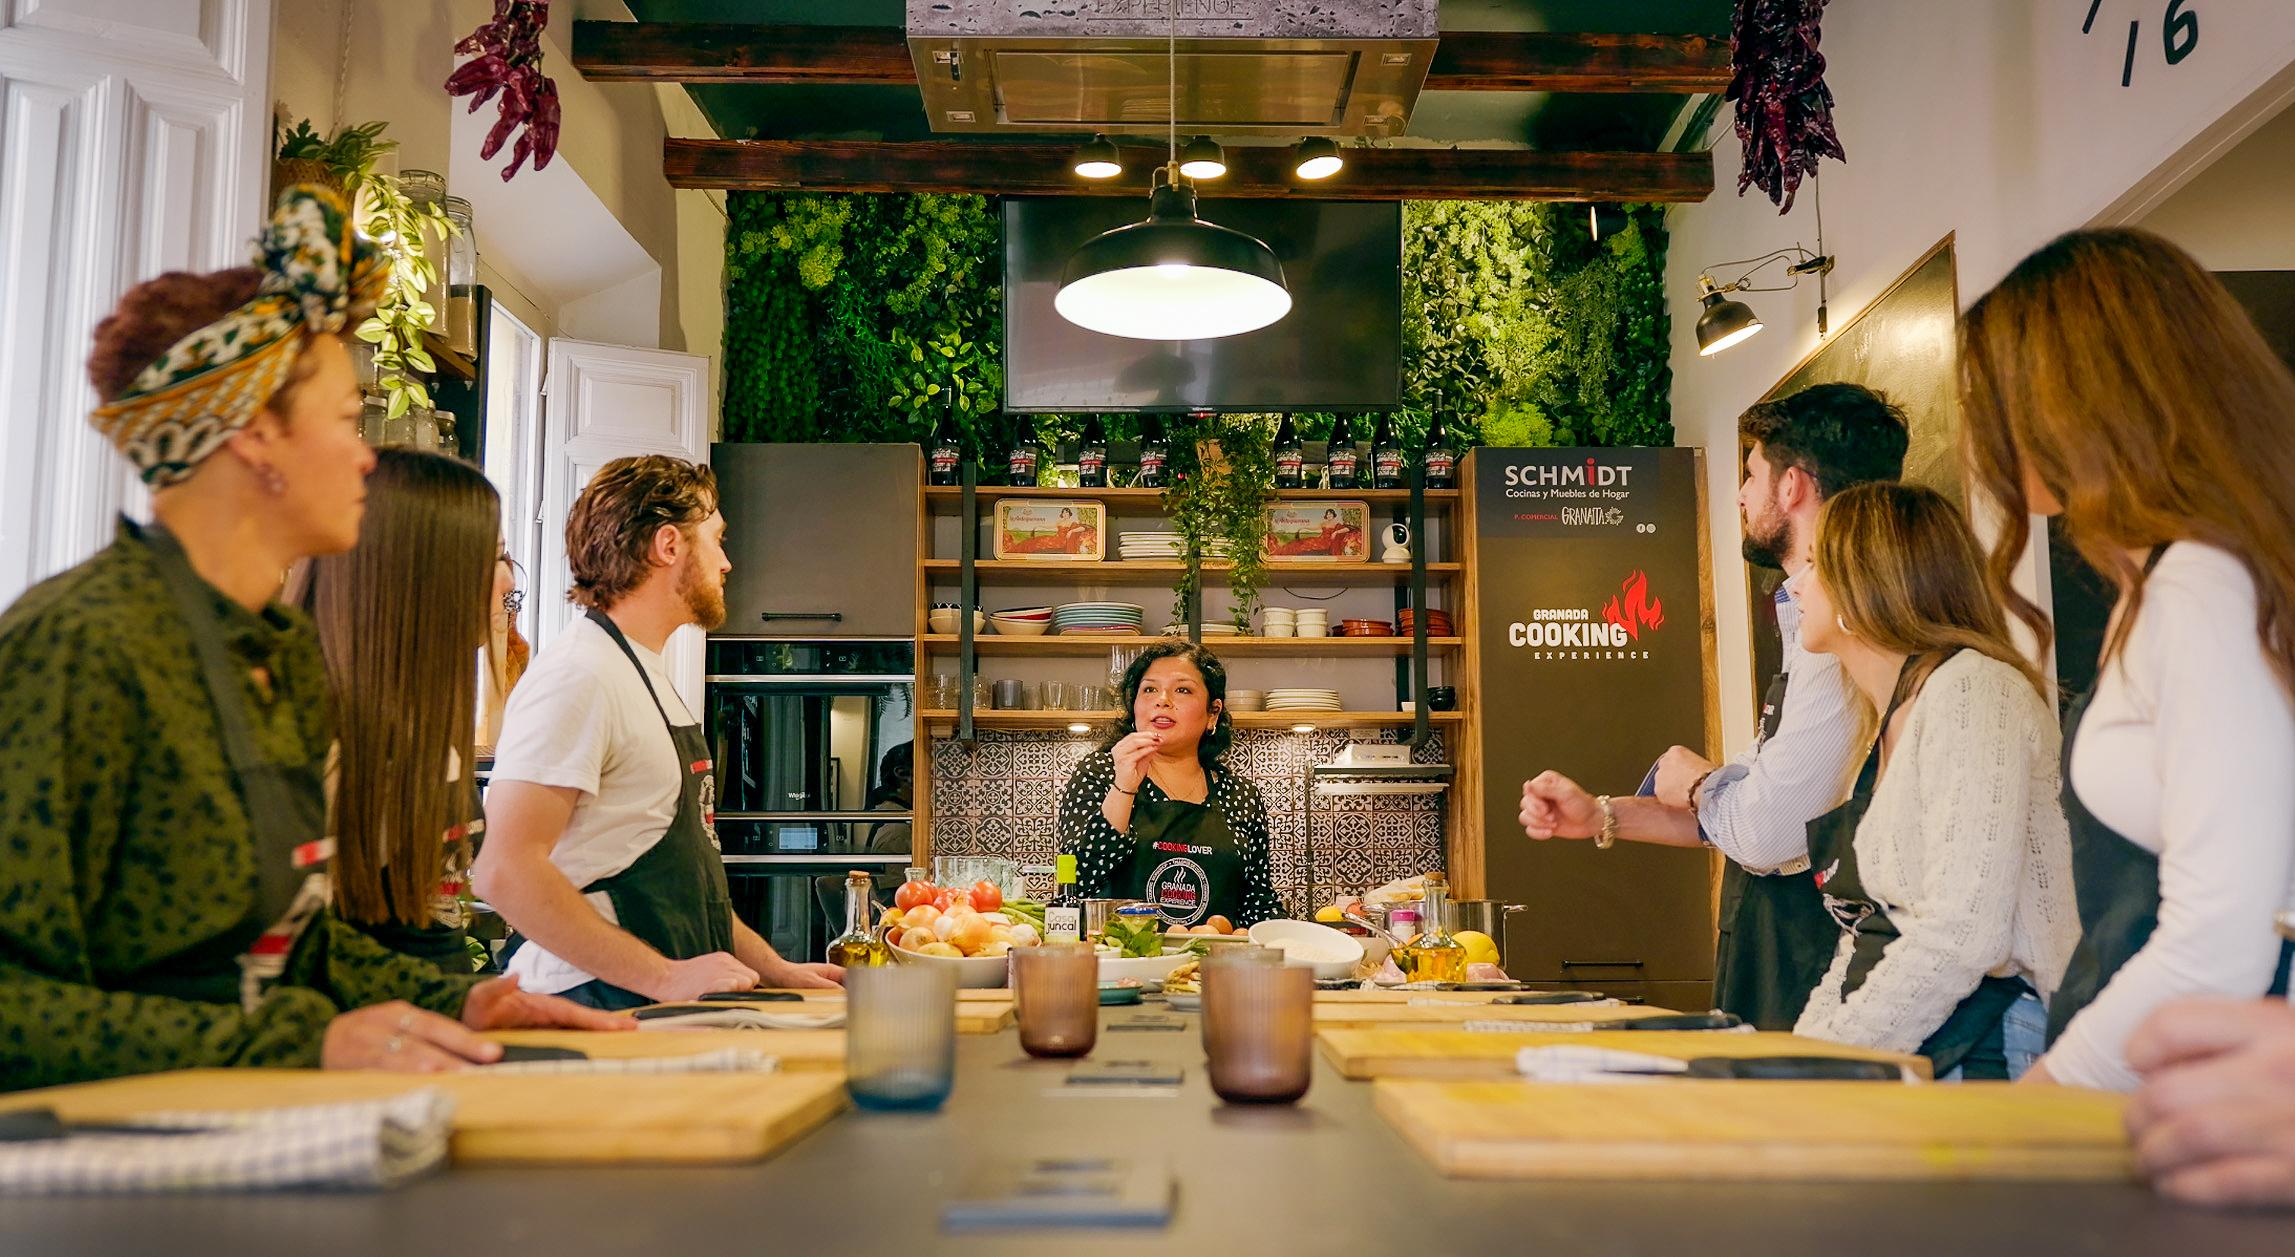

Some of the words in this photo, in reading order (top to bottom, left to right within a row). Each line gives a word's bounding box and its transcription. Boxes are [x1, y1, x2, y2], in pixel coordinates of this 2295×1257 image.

[1505, 488, 1541, 498] Cocinas
[1542, 491, 1549, 500] y
[1550, 488, 1587, 498] Muebles
[1588, 489, 1600, 498] de
[1602, 489, 1630, 500] Hogar
[1533, 609, 1589, 620] GRANADA
[1508, 622, 1628, 647] COOKING
[1534, 651, 1649, 660] EXPERIENCE
[1161, 881, 1196, 893] GRANADA
[1048, 911, 1074, 922] Casa
